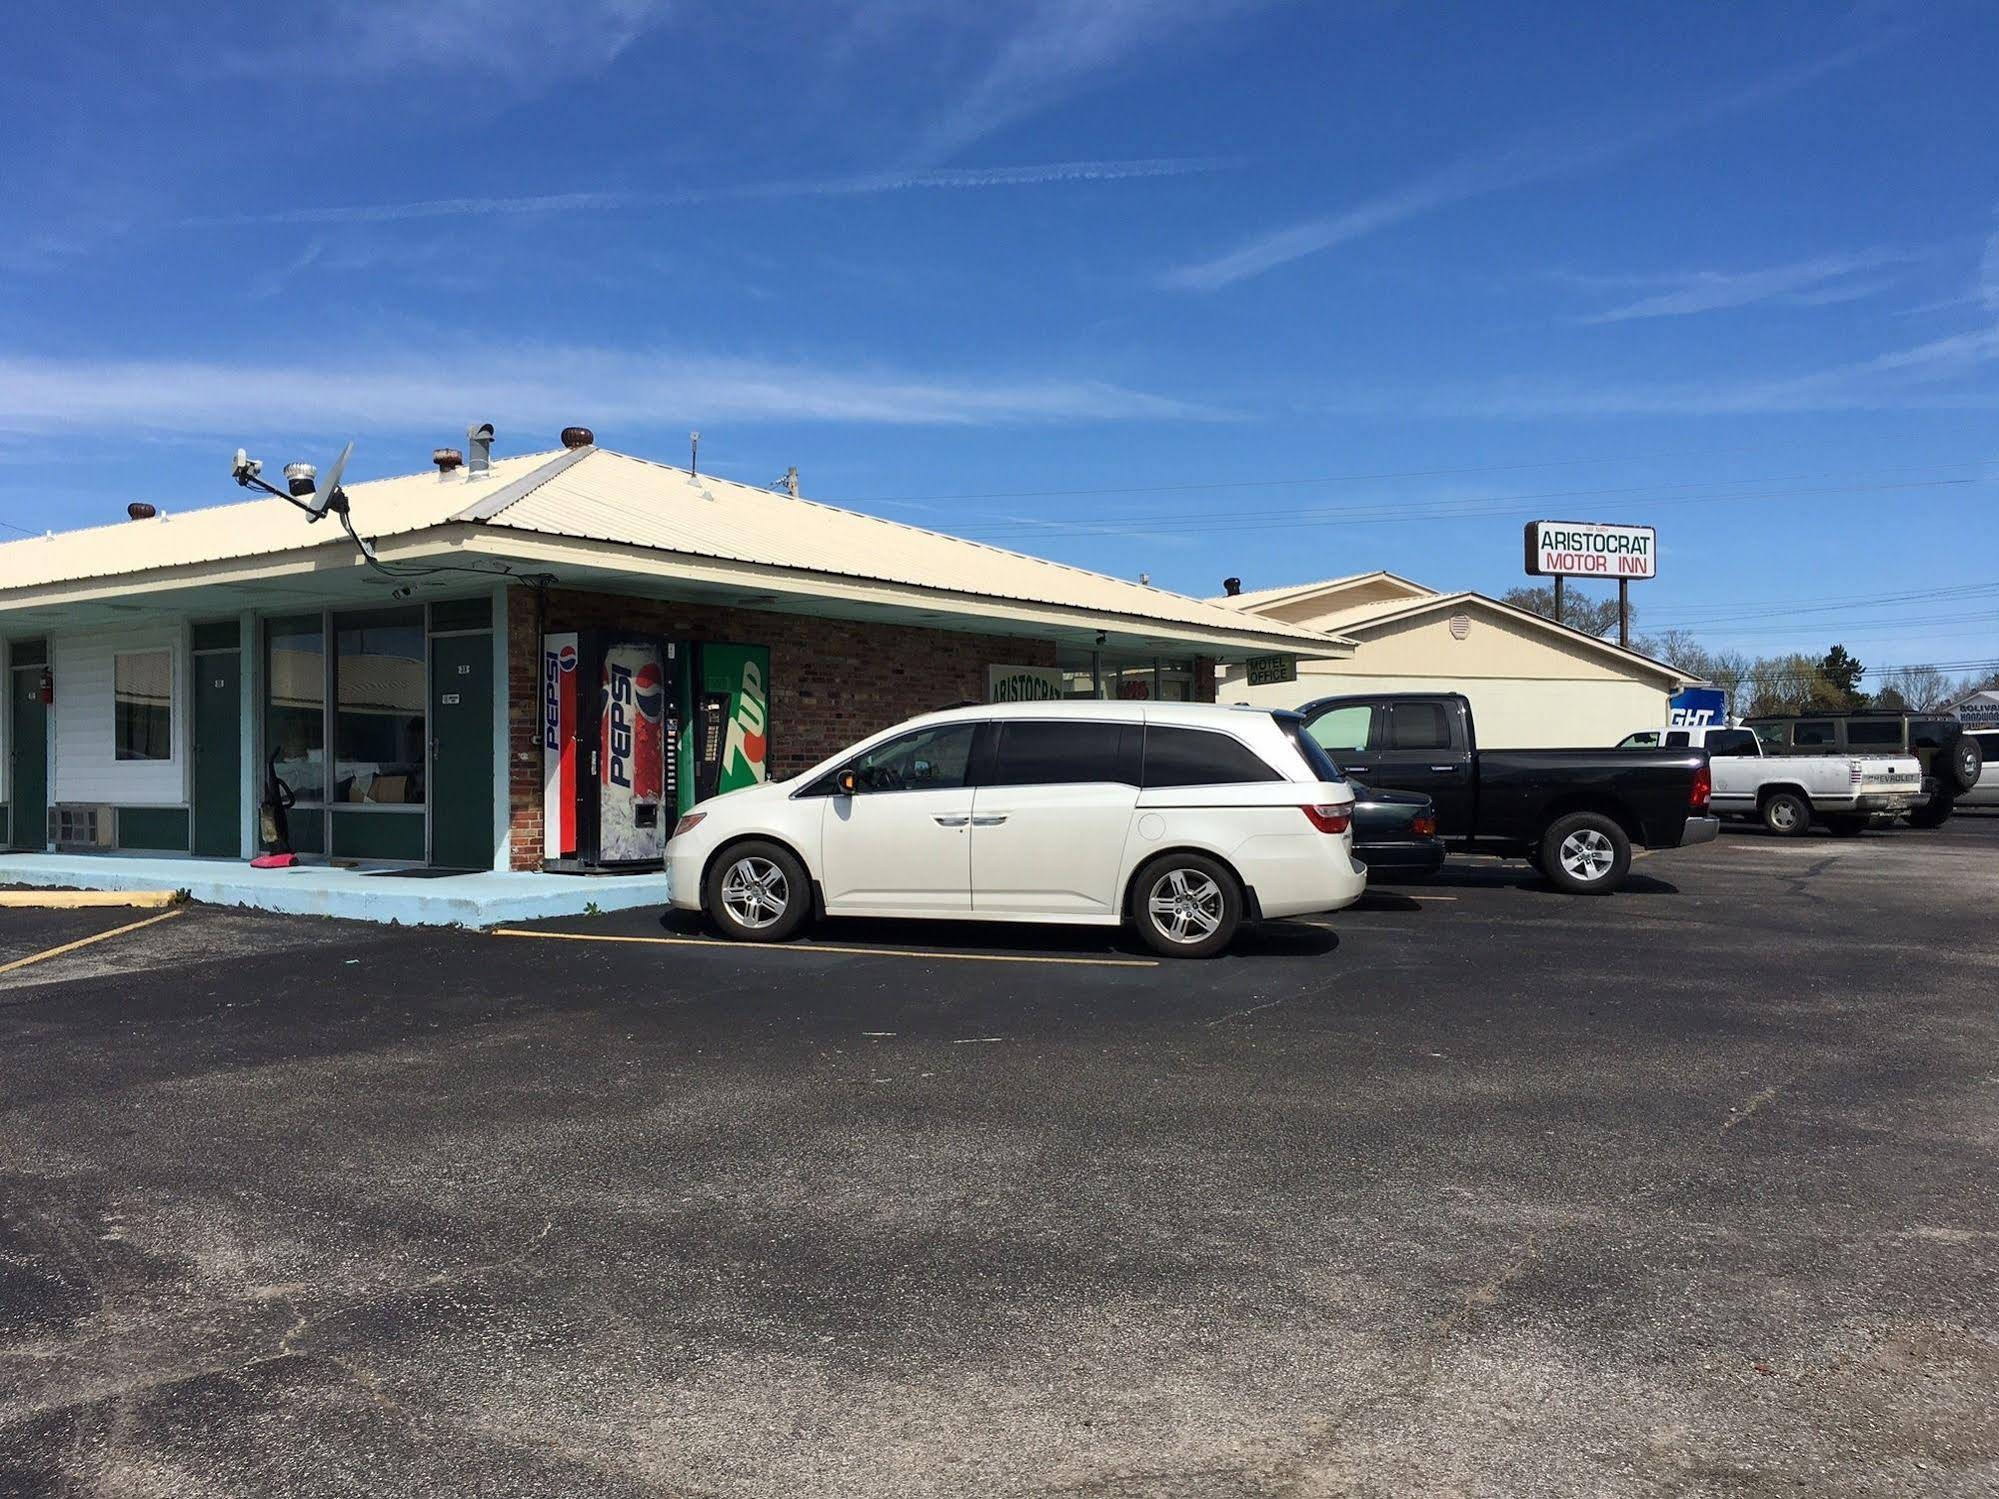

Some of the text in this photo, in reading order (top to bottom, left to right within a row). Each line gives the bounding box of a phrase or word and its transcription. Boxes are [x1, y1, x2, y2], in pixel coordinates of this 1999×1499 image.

[1541, 531, 1650, 555] ARISTOCRAT
[1546, 553, 1647, 574] MOTOR INN
[1250, 656, 1286, 671] MOTEL
[1250, 668, 1287, 683] OFFICE
[546, 651, 561, 751] PEPSI
[1960, 704, 1999, 712] BOLIVA
[610, 663, 632, 788] PEPSI
[723, 661, 766, 783] 7UP
[1868, 774, 1914, 783] CHEVROLET
